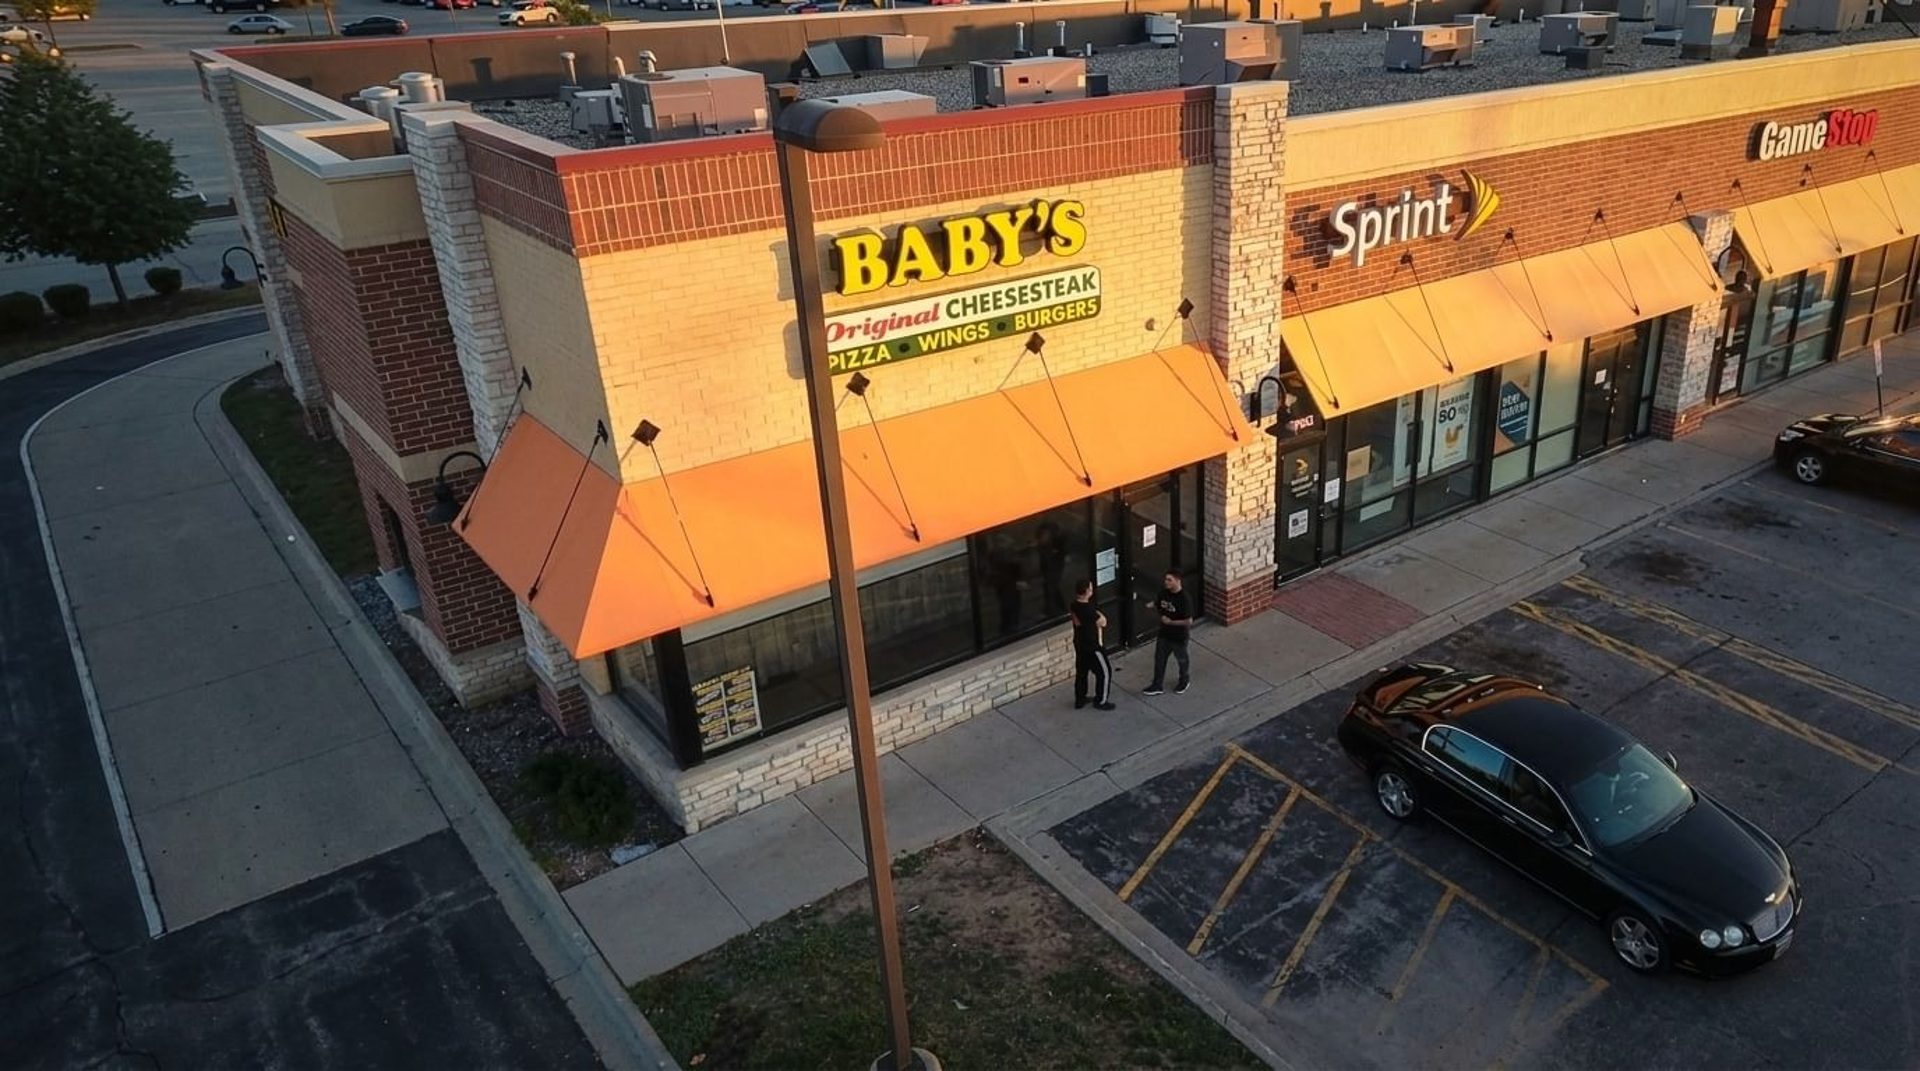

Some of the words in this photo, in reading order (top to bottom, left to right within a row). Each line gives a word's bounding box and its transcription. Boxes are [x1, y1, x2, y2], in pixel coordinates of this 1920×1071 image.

[1759, 110, 1878, 161] GameStop
[834, 199, 1087, 297] BABY'S
[1329, 182, 1454, 267] Sprint
[826, 303, 940, 343] Original
[945, 271, 1097, 320] CHEESESTEAK
[828, 343, 892, 370] PIZZA
[918, 322, 990, 352] WINGS
[1014, 298, 1098, 332] BURGERS
